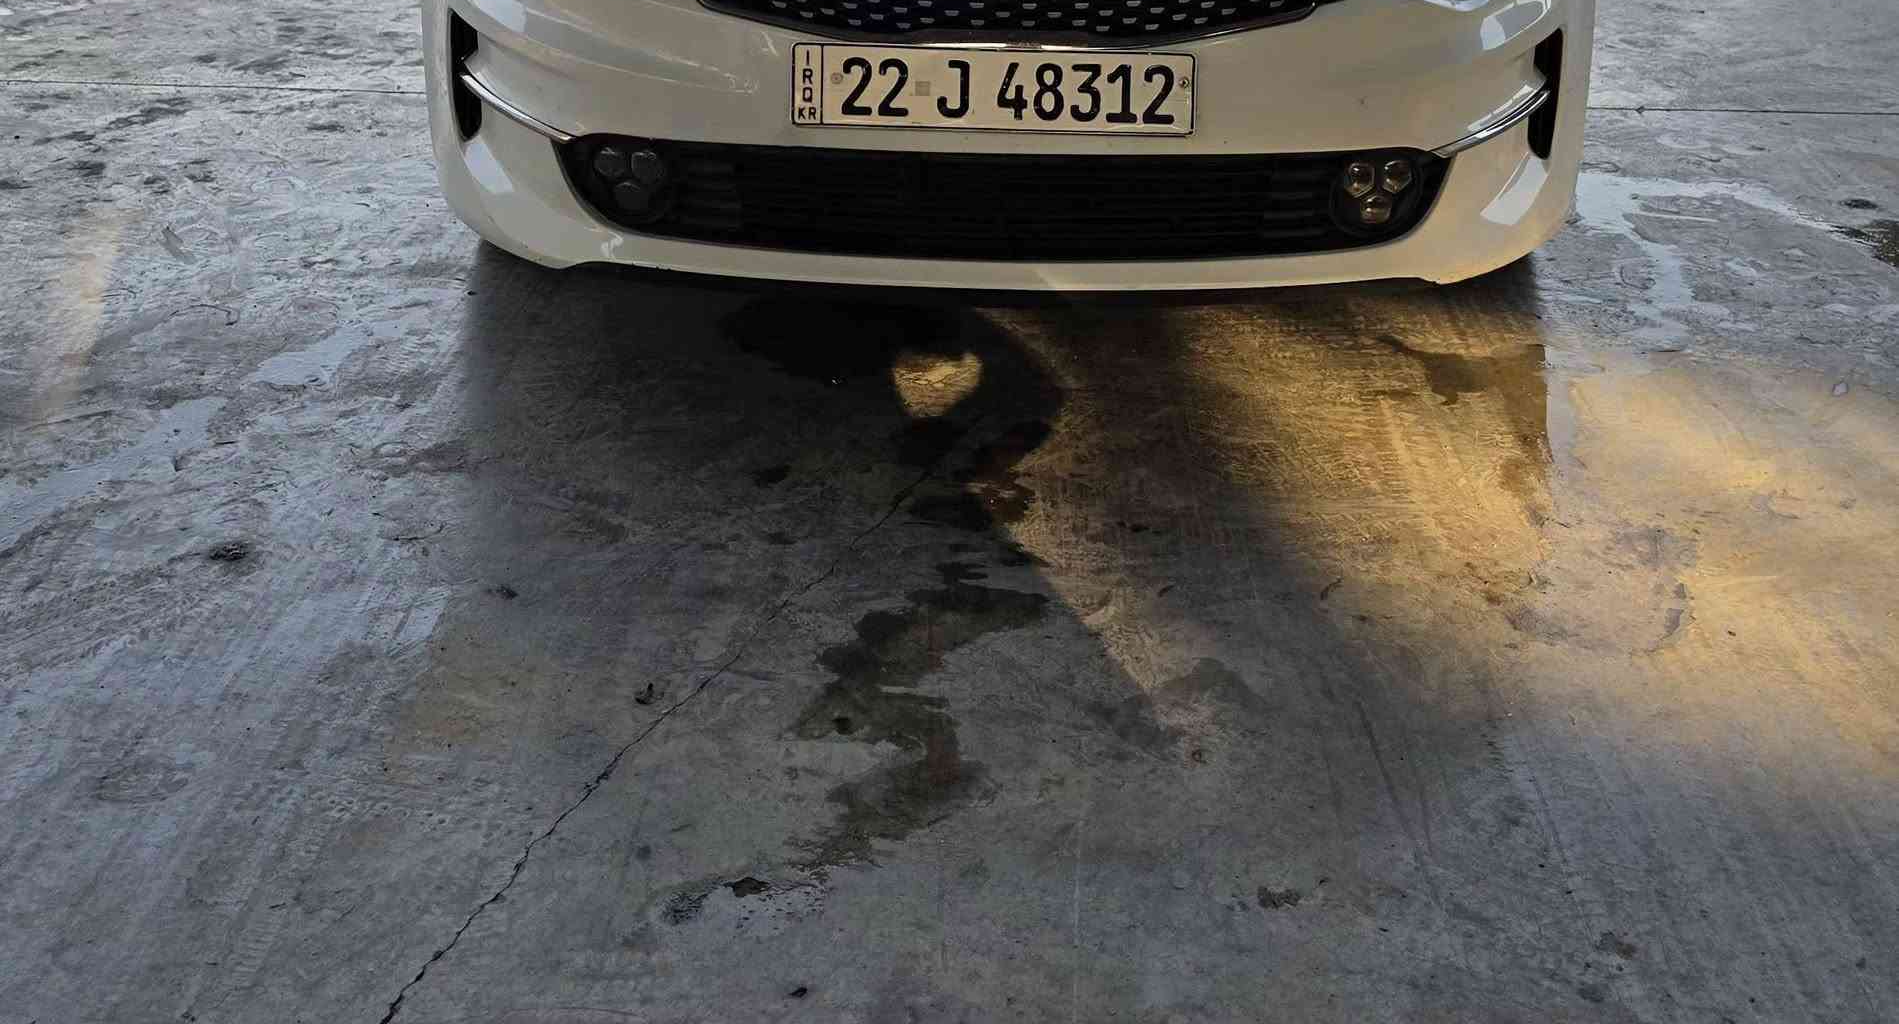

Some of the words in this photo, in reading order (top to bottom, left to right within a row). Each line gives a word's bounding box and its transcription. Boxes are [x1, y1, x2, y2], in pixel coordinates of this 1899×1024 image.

[841, 57, 909, 118] 22
[937, 59, 971, 119] J
[997, 62, 1175, 125] 48312
[798, 107, 816, 120] KR
